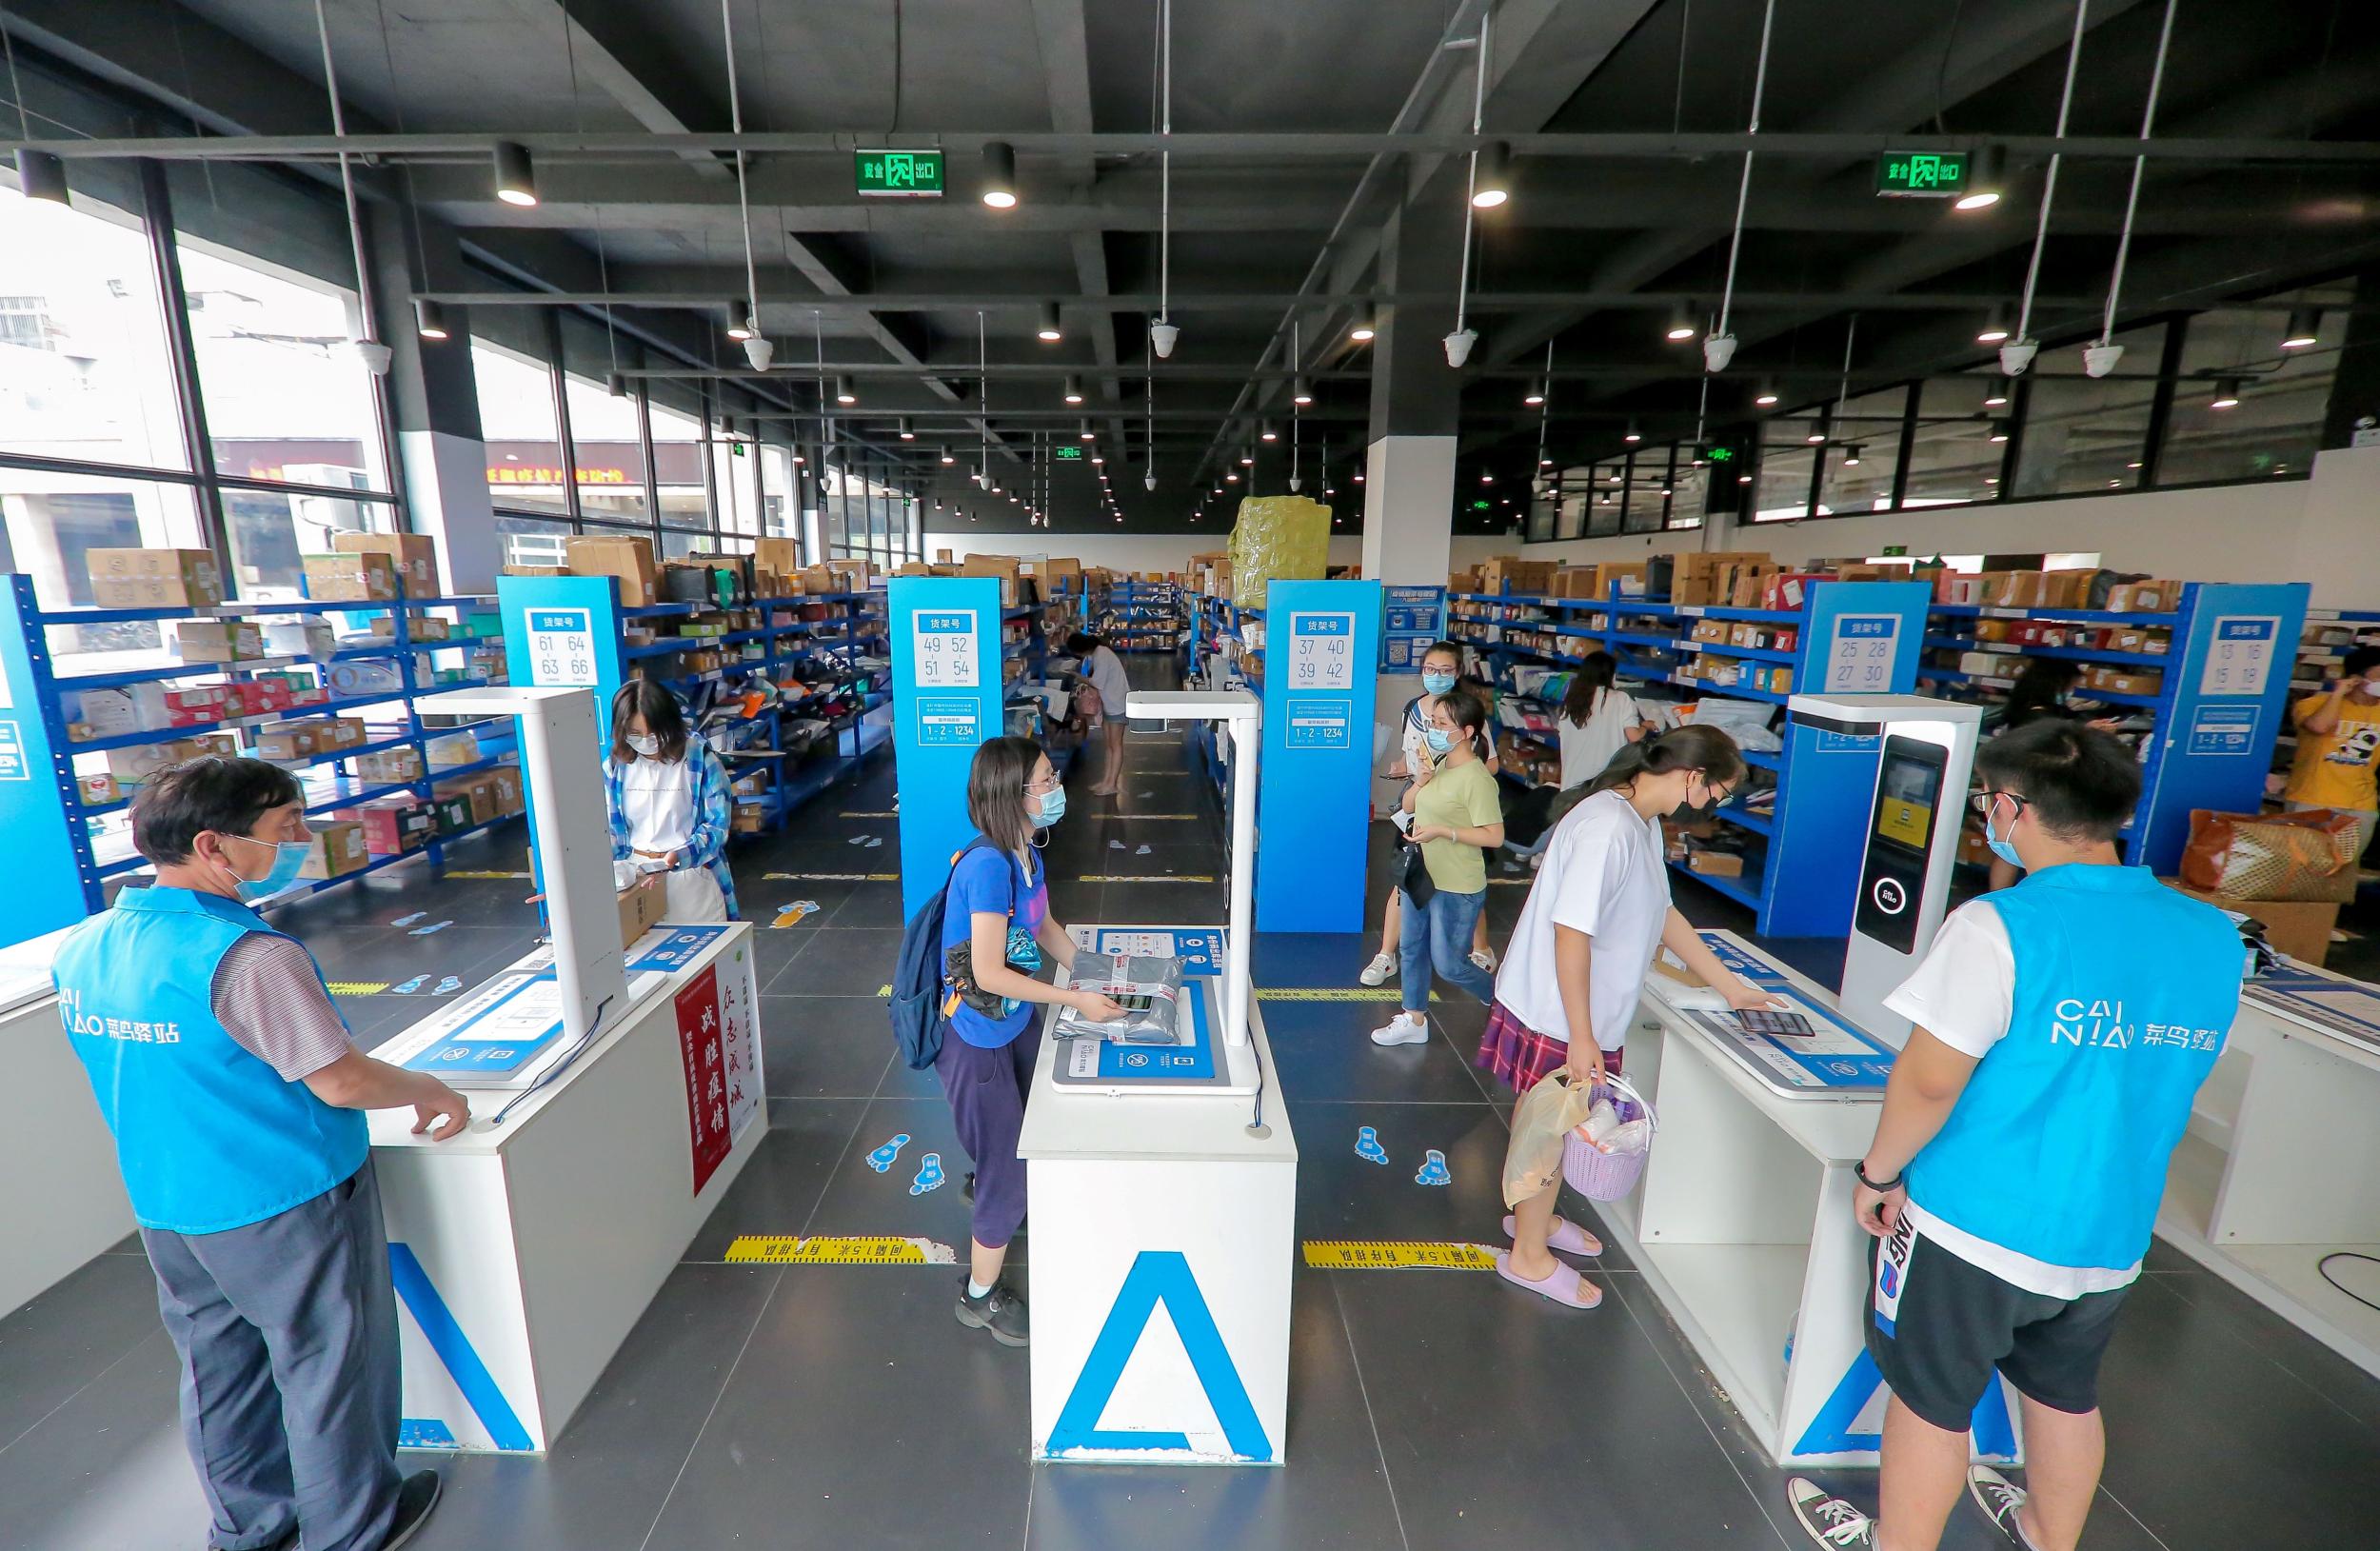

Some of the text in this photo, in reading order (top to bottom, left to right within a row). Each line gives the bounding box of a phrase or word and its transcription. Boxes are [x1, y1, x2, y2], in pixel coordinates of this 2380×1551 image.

[915, 163, 935, 179] 出口
[930, 618, 961, 629] 货架号
[1307, 621, 1339, 631] 货架号
[539, 636, 585, 651] 61 64
[923, 637, 967, 653] 49 52
[1299, 639, 1344, 655] 37 40
[1840, 642, 1887, 658] 25 28
[542, 659, 588, 675] 63 66
[925, 661, 969, 676] 51 54
[1298, 663, 1343, 678] 39 42
[1836, 666, 1883, 682] 27 30
[59, 987, 80, 1011] AI
[2055, 999, 2123, 1024] CAI
[106, 1018, 180, 1044] 菜鸟驿站
[723, 984, 744, 1109] 众志成城
[701, 1004, 724, 1134] 战胜疫情
